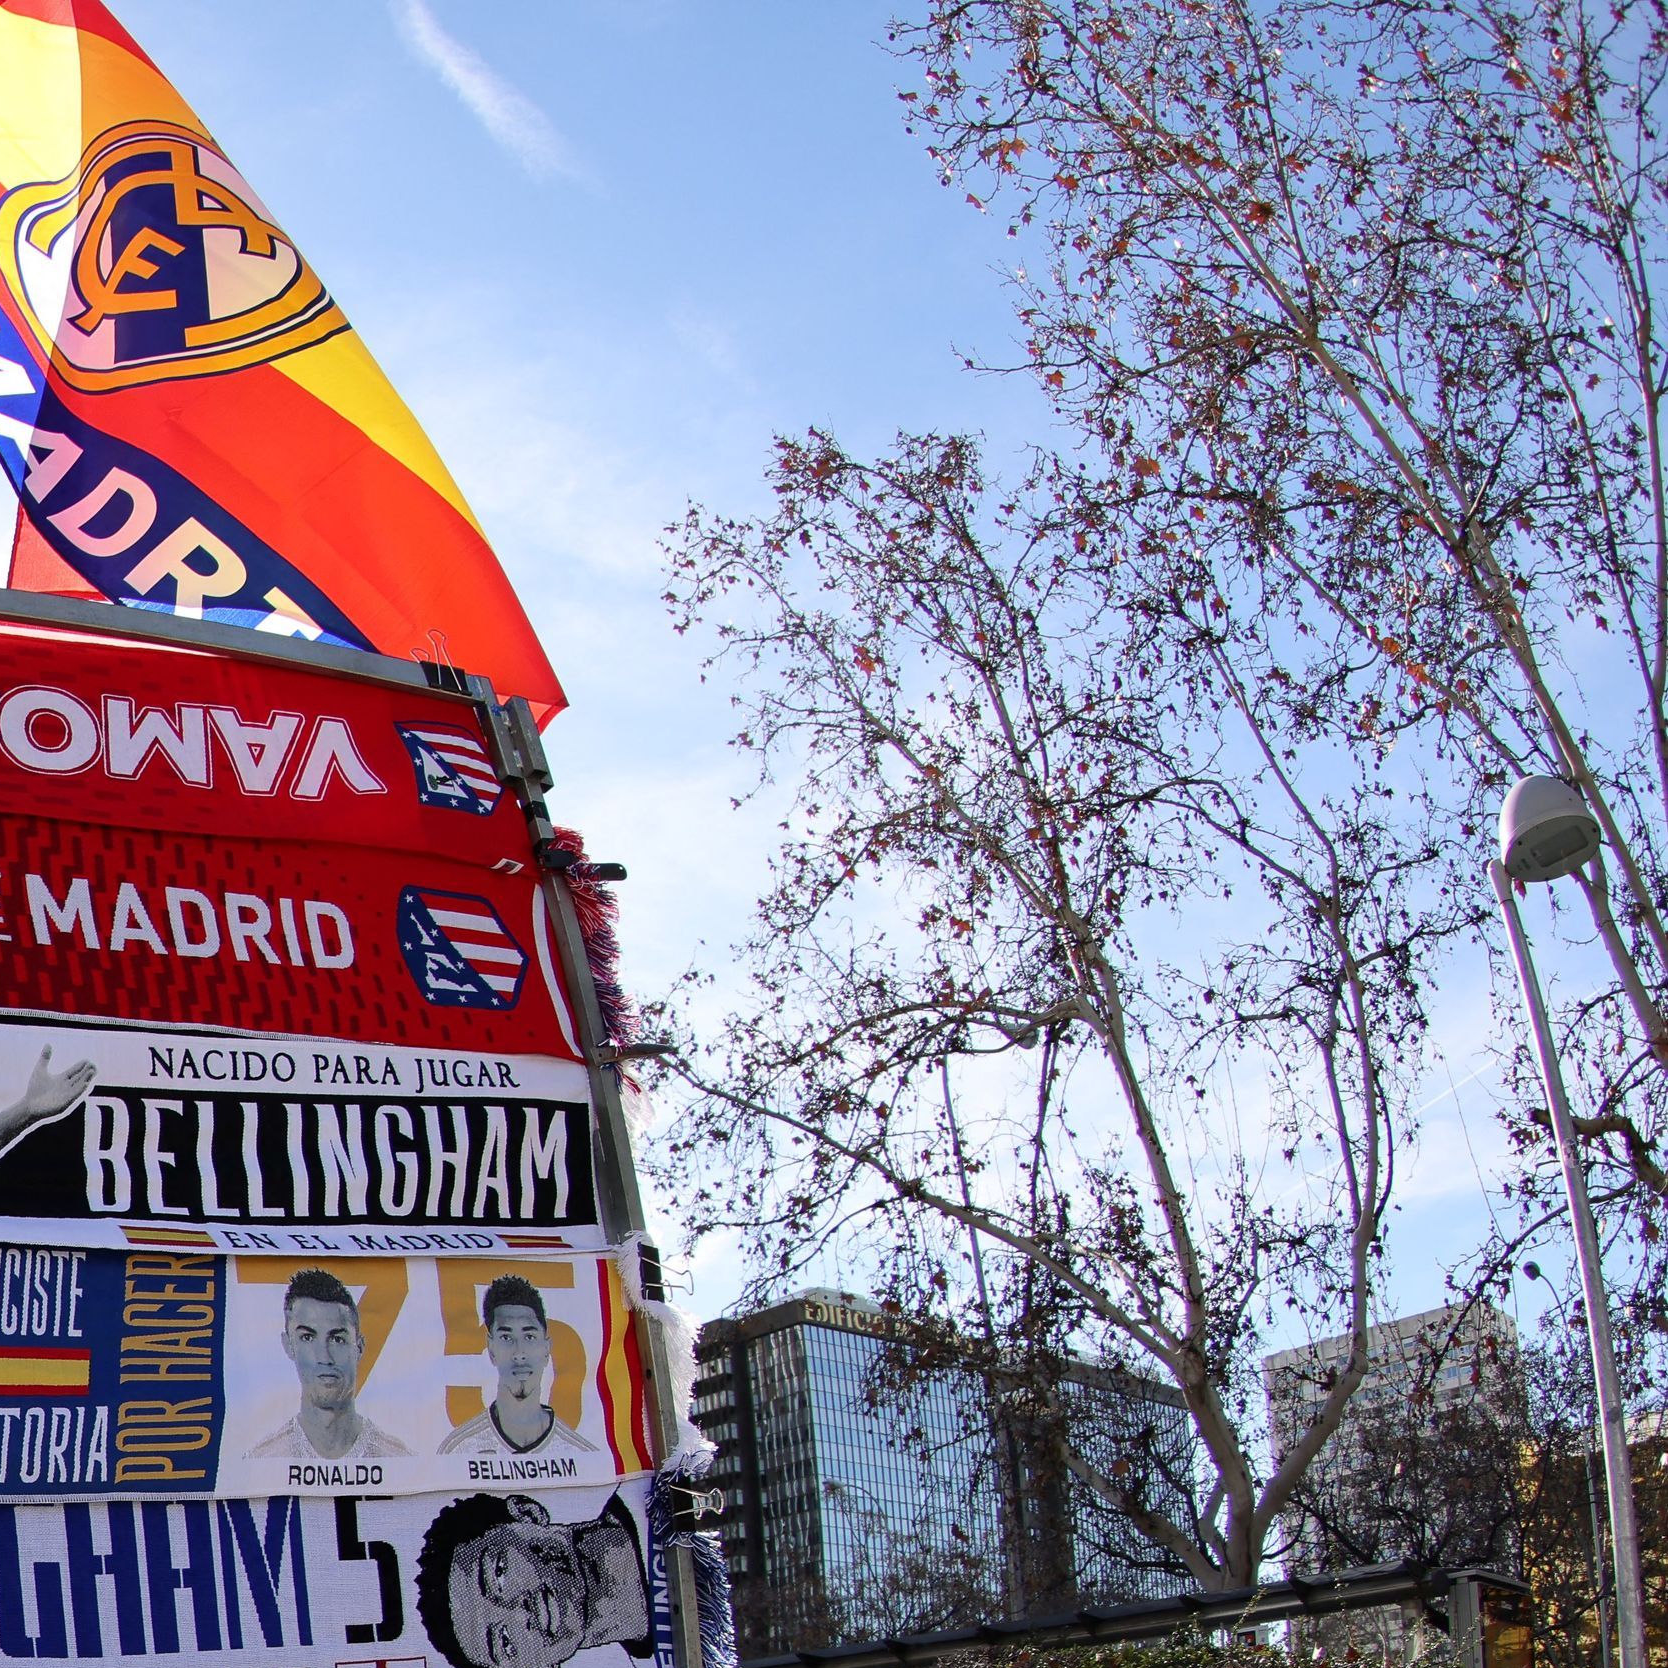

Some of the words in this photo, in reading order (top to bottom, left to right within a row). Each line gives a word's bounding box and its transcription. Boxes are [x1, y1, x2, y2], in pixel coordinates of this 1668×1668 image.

[24, 873, 355, 970] MADRID
[147, 1045, 296, 1083] NACIDO
[314, 1052, 403, 1090] PARA
[413, 1057, 521, 1095] JUGAR
[84, 1096, 570, 1221] BELLINGHAM
[223, 1230, 272, 1252] EN
[293, 1230, 333, 1251] EL
[344, 1231, 494, 1252] MADRID
[119, 1253, 215, 1384] HACER
[115, 1401, 214, 1484] POR
[287, 1464, 384, 1488] RONALDO
[467, 1457, 578, 1481] BELLINGHAM
[334, 1496, 404, 1645] 5
